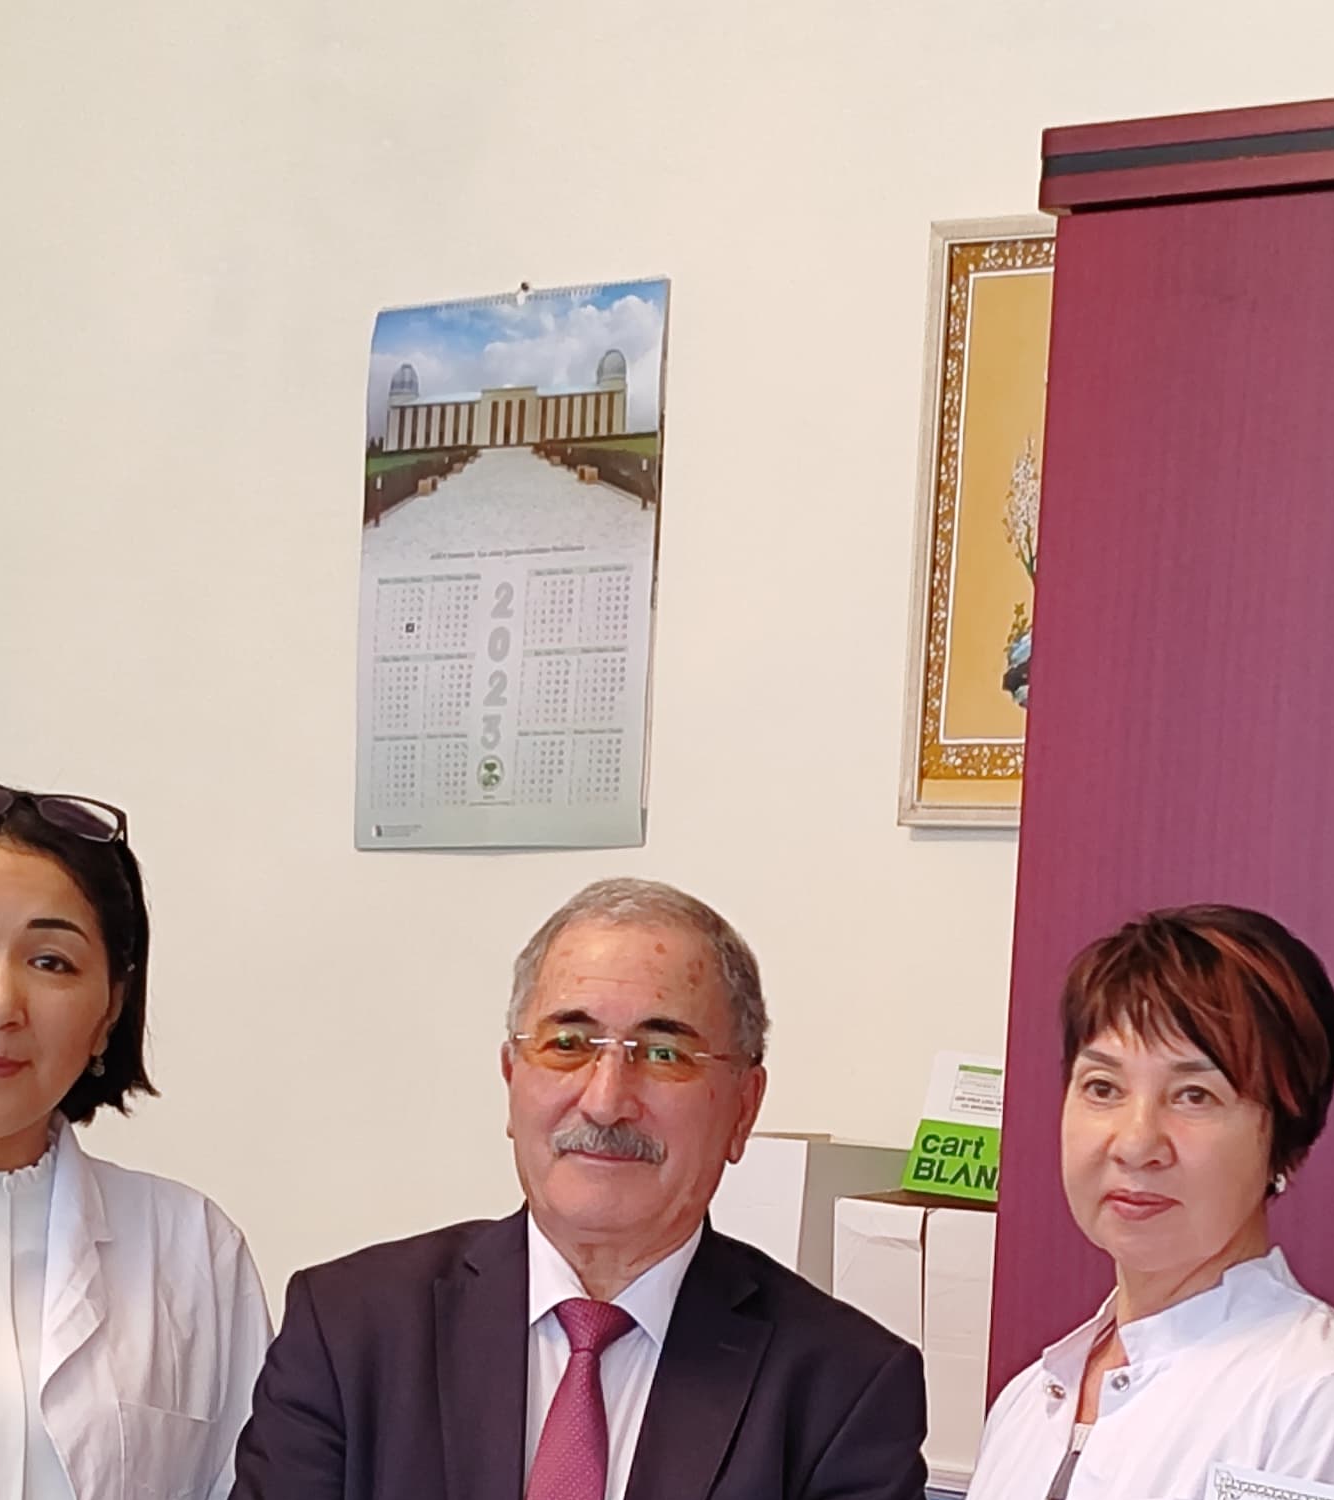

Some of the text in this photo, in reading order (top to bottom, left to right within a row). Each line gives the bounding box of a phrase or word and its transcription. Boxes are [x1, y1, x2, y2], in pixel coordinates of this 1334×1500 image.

[479, 581, 514, 750] 2023
[921, 1134, 985, 1160] cart
[912, 1156, 999, 1191] BLAN
